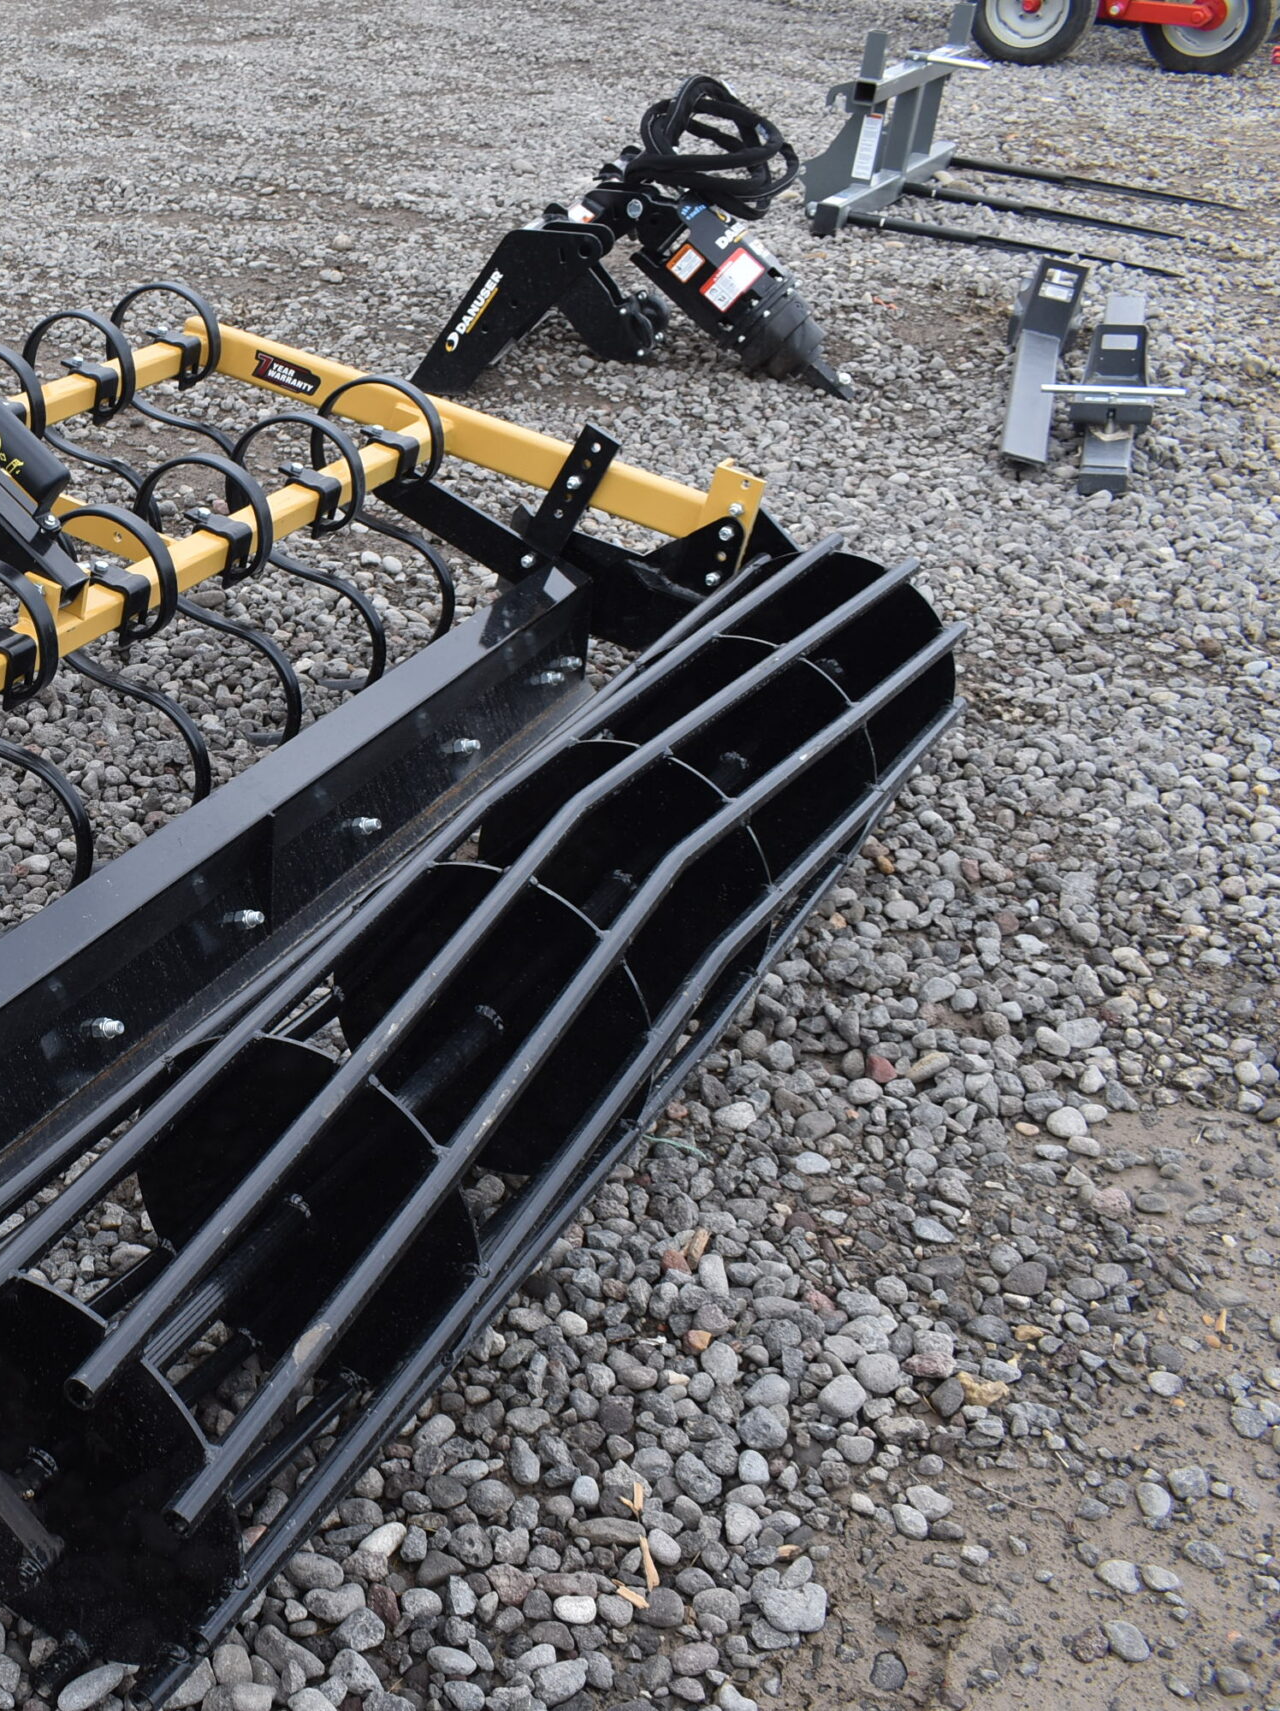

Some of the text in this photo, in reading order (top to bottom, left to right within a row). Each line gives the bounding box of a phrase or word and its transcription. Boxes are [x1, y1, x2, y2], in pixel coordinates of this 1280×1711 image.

[455, 270, 504, 335] DANUSER
[257, 352, 296, 377] 7 YEAR
[267, 368, 314, 392] WARRANTY
